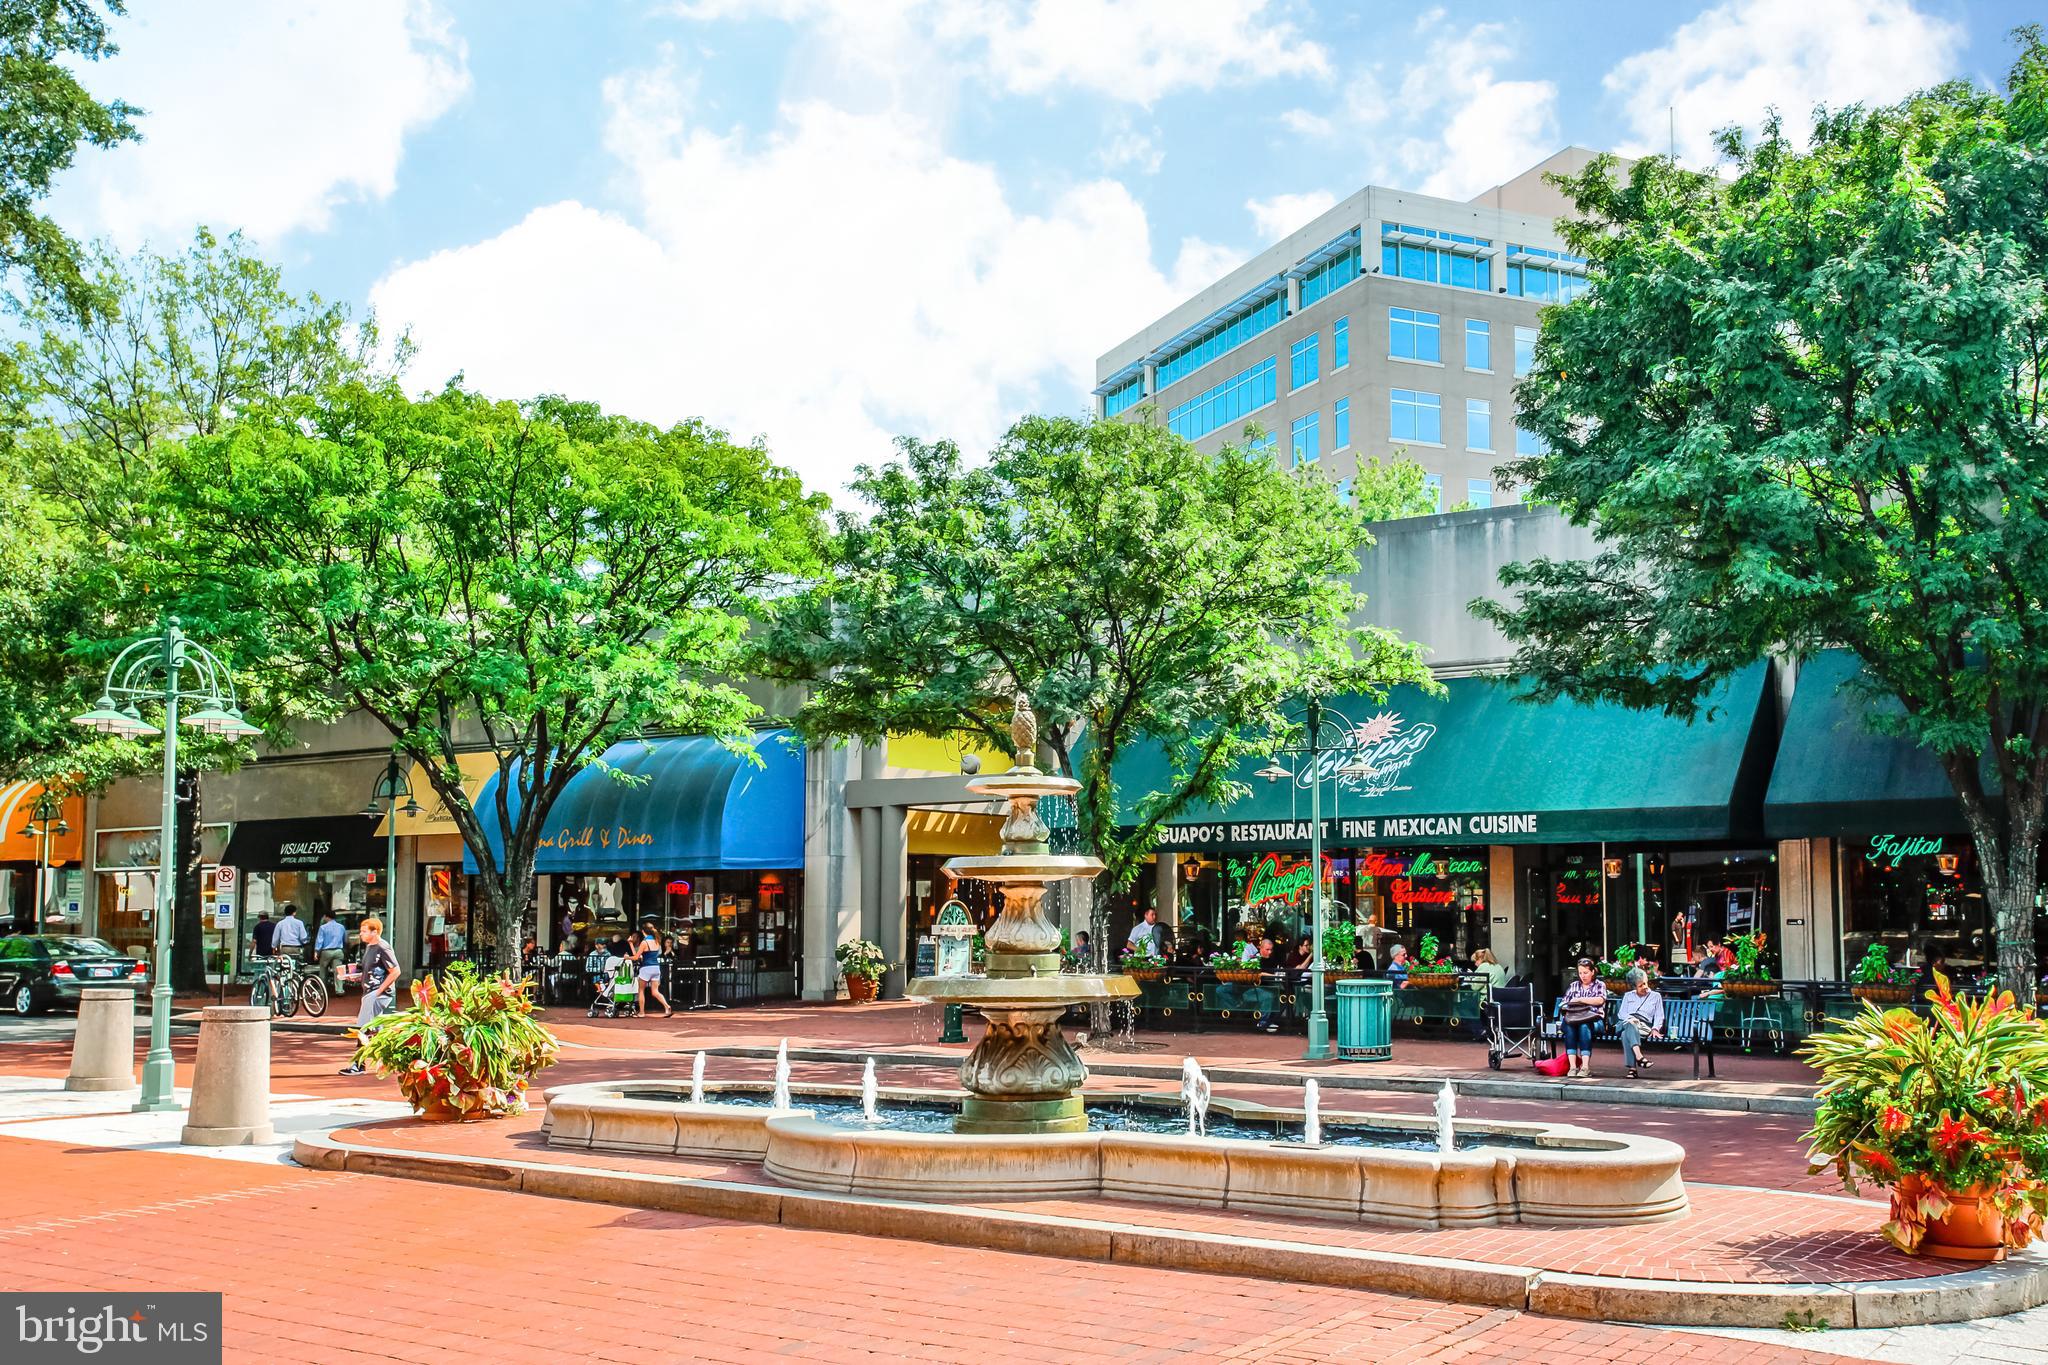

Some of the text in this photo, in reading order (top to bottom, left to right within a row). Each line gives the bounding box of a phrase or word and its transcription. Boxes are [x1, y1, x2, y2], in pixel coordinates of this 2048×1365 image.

[558, 828, 594, 853] Grill
[618, 826, 654, 849] Diner
[1158, 825, 1225, 844] GUAPO'S
[1342, 820, 1376, 838] FINE
[1383, 817, 1462, 837] MEXICAN
[1469, 814, 1537, 833] CUISINE
[280, 841, 331, 855] VISUALEYES
[1866, 834, 1943, 868] Fajitas
[1405, 853, 1481, 876] Mecan
